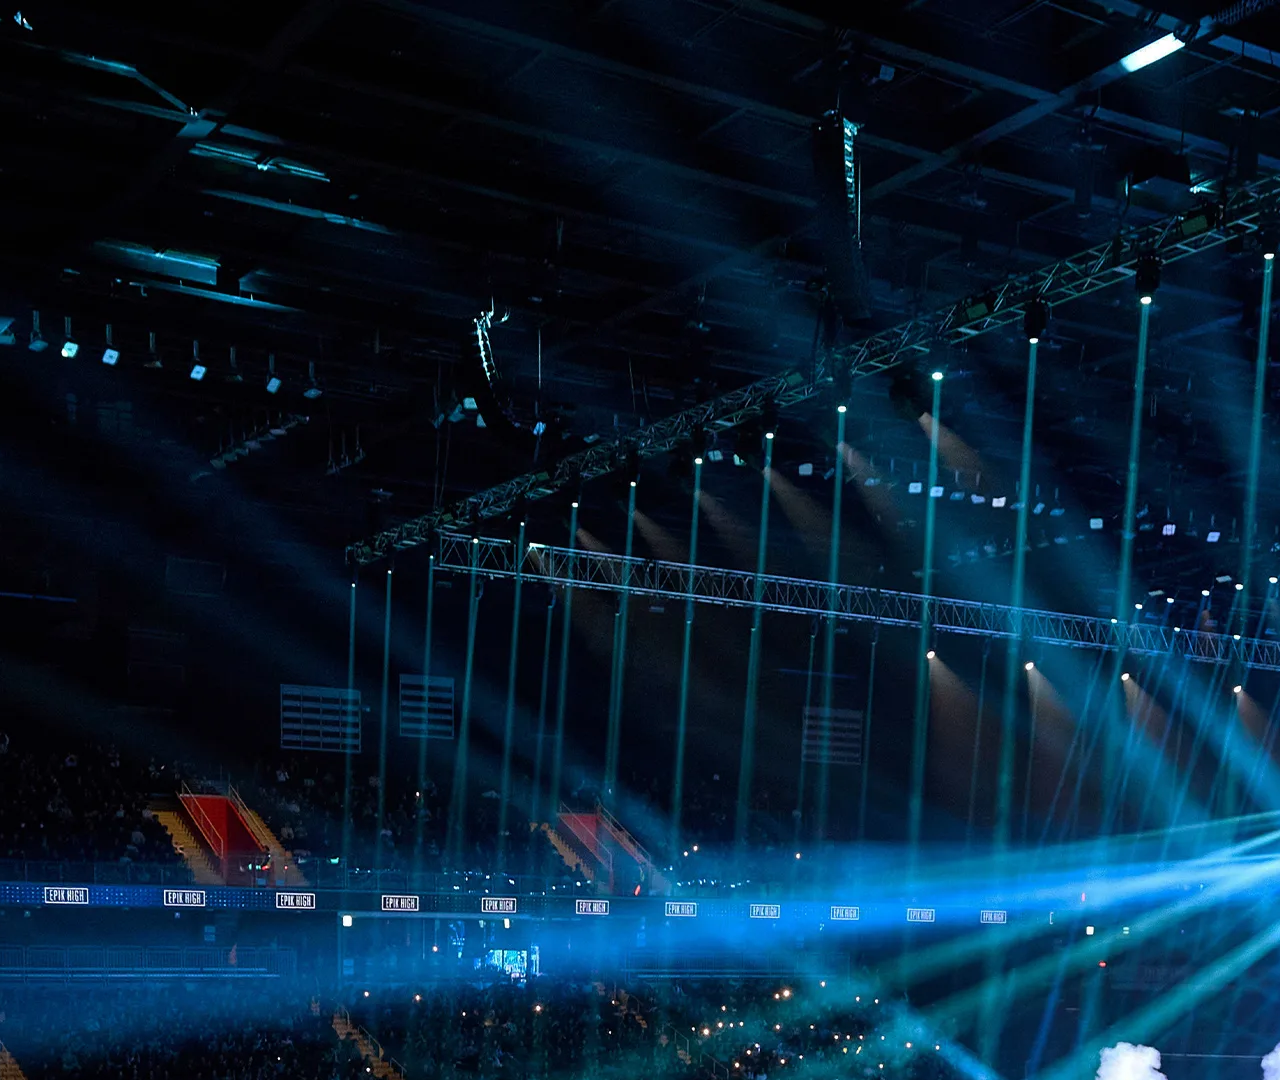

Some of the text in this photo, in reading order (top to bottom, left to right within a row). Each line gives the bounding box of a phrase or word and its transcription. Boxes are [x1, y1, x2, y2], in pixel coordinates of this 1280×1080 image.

[49, 889, 84, 902] EPIK HIGH
[168, 892, 201, 905] EPIK HIGH
[279, 895, 310, 908] EPIK HIGH
[385, 897, 415, 910] EPIK HIGH
[485, 899, 513, 911] EPIK HIGH
[579, 902, 605, 913] EPIK HIGH
[668, 904, 693, 916] EPIK HIGH
